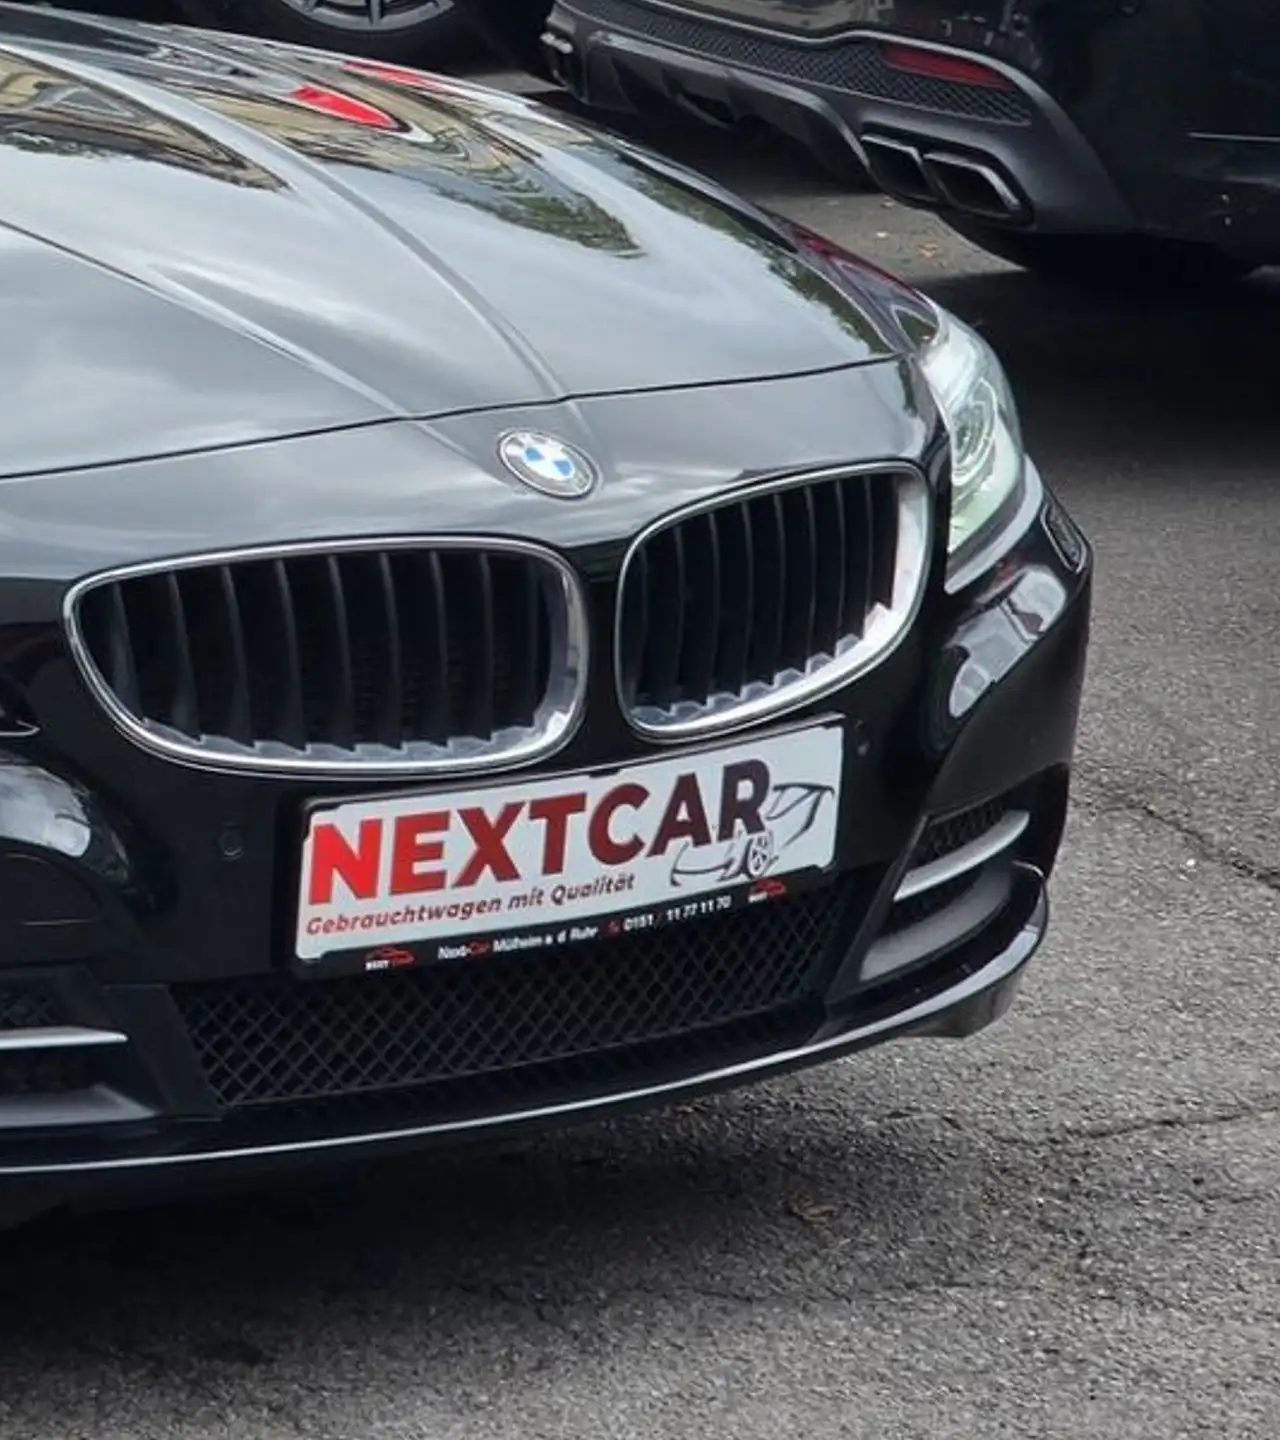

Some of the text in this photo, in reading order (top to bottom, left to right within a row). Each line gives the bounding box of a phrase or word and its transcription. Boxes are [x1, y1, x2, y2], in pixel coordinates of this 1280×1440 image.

[307, 758, 771, 905] NEXTCAR
[306, 873, 636, 935] Gebrauchtwagen mit Qualität
